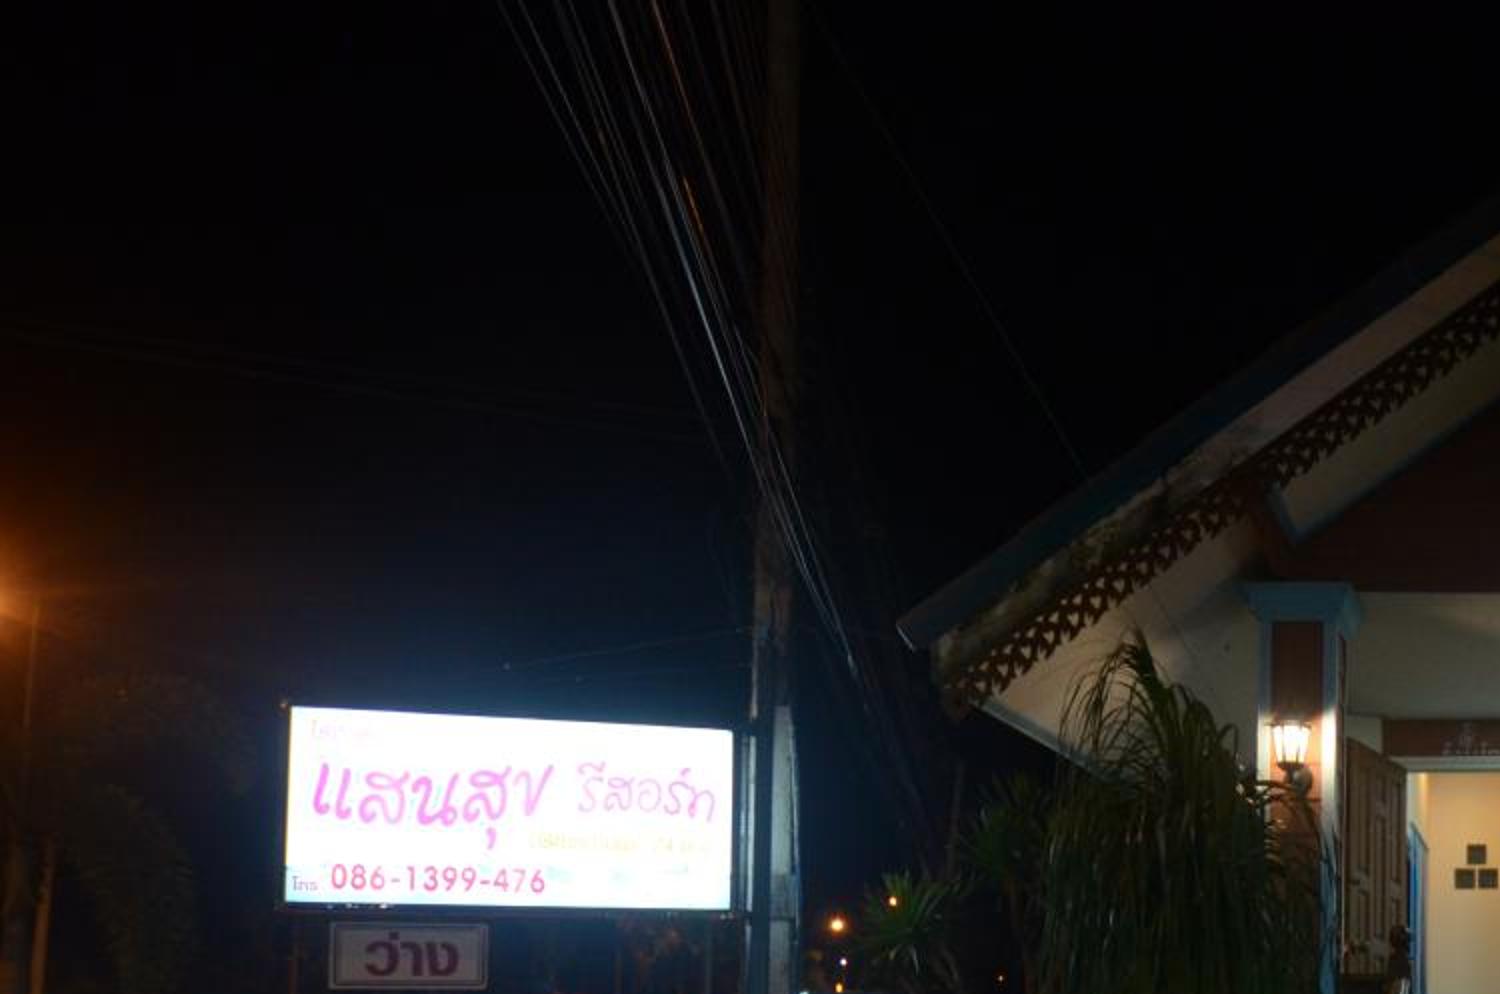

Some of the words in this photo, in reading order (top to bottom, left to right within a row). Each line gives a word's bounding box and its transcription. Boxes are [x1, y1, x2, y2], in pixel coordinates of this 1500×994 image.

[313, 763, 553, 849] แสนสุข
[331, 863, 547, 895] 086-1399-476
[364, 931, 459, 977] ว่าง
